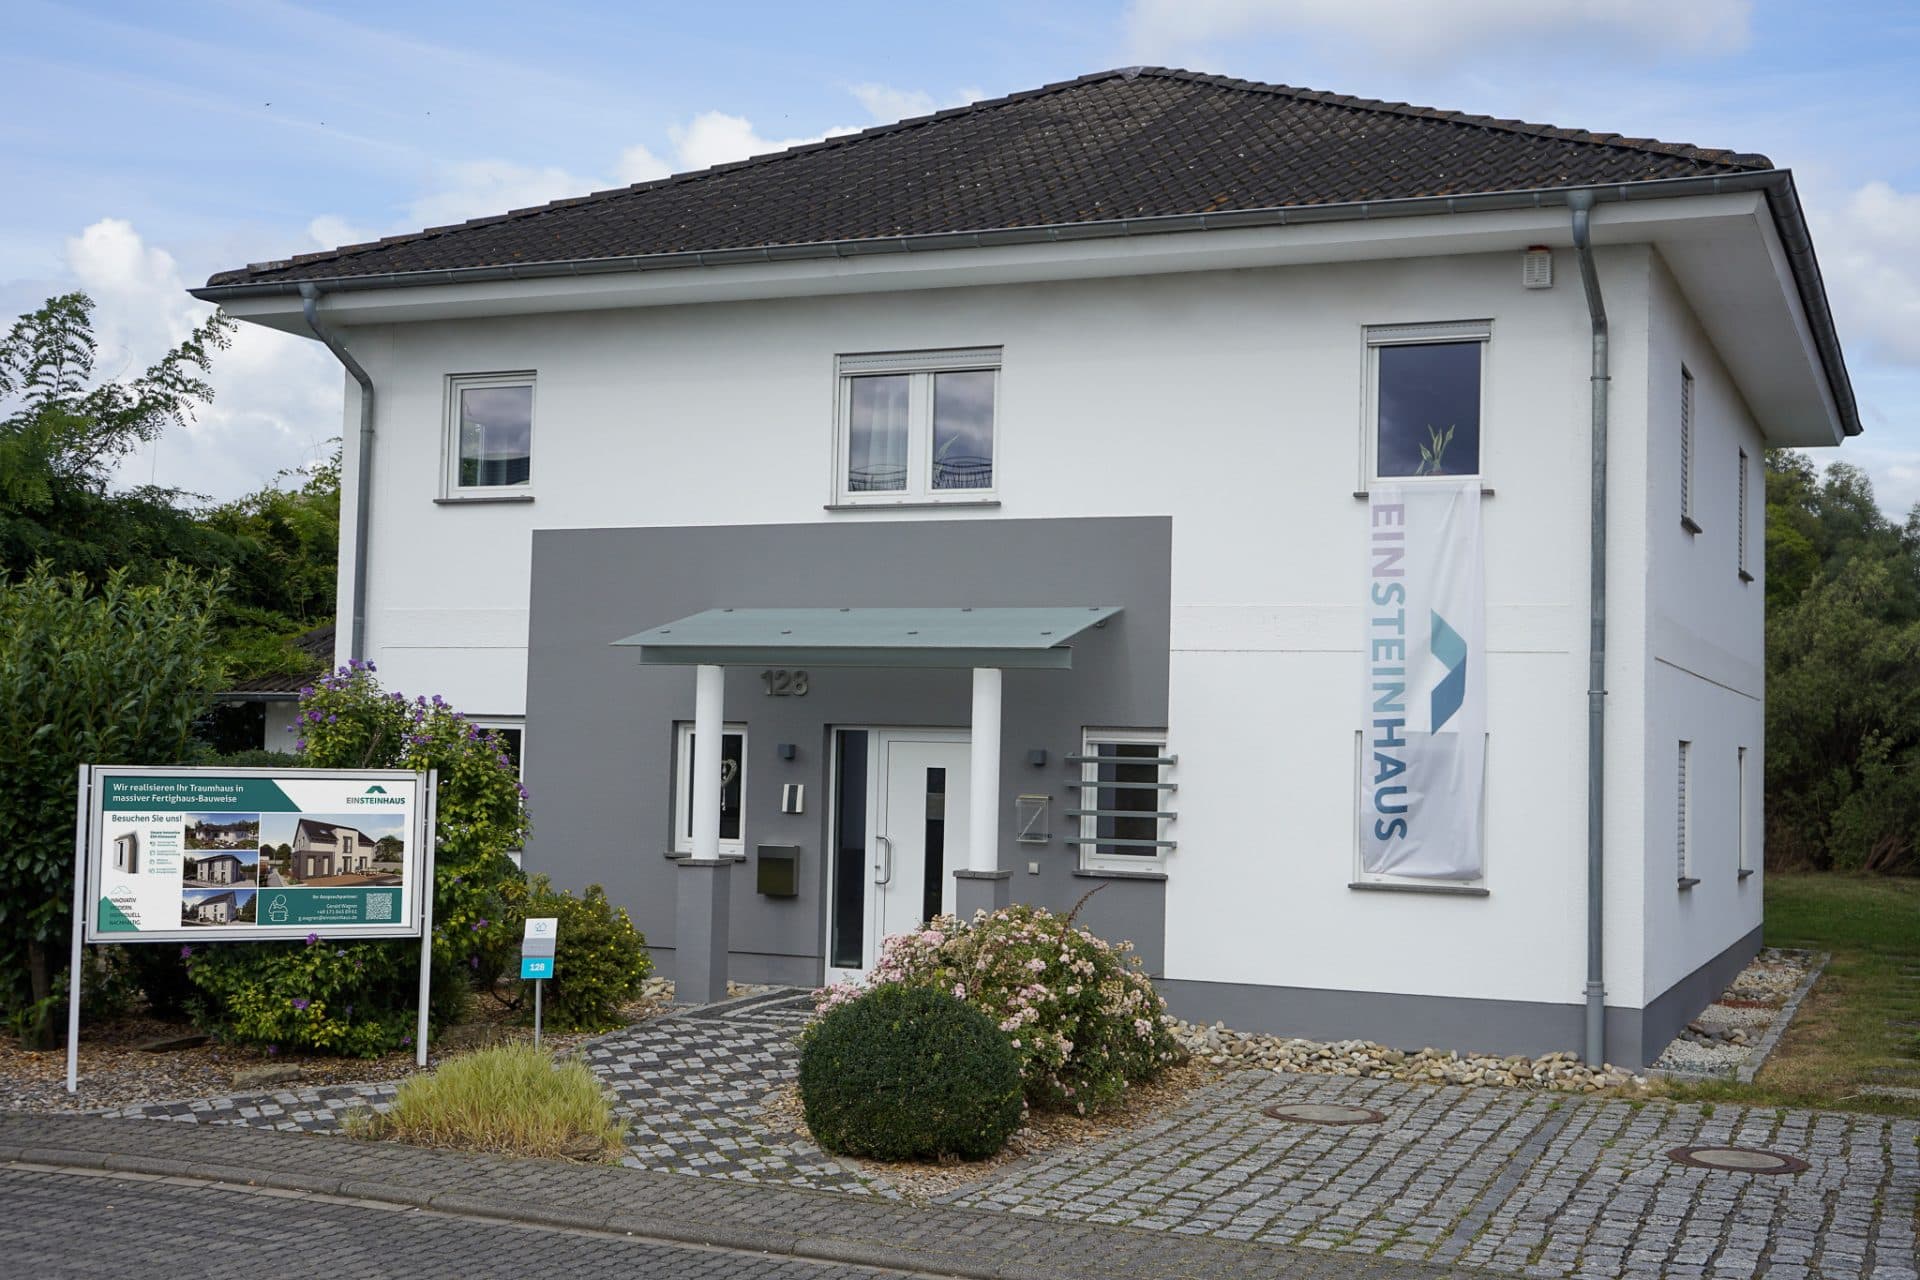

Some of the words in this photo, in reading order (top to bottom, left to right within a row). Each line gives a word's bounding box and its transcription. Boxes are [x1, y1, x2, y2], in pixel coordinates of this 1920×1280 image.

[1371, 503, 1408, 841] EINSTEINHAUS
[760, 670, 808, 696] 128
[113, 783, 128, 791] Wir
[130, 783, 175, 792] realisieren
[176, 784, 187, 792] Ihr
[190, 784, 234, 793] Traumhaus
[235, 784, 244, 793] in
[112, 793, 150, 802] massiver
[152, 794, 237, 805] Fertighaus-Bauweise
[346, 797, 406, 805] EINSTEINHAUS
[112, 814, 150, 822] Besuchen
[151, 815, 164, 823] Sie
[166, 815, 182, 823] uns!
